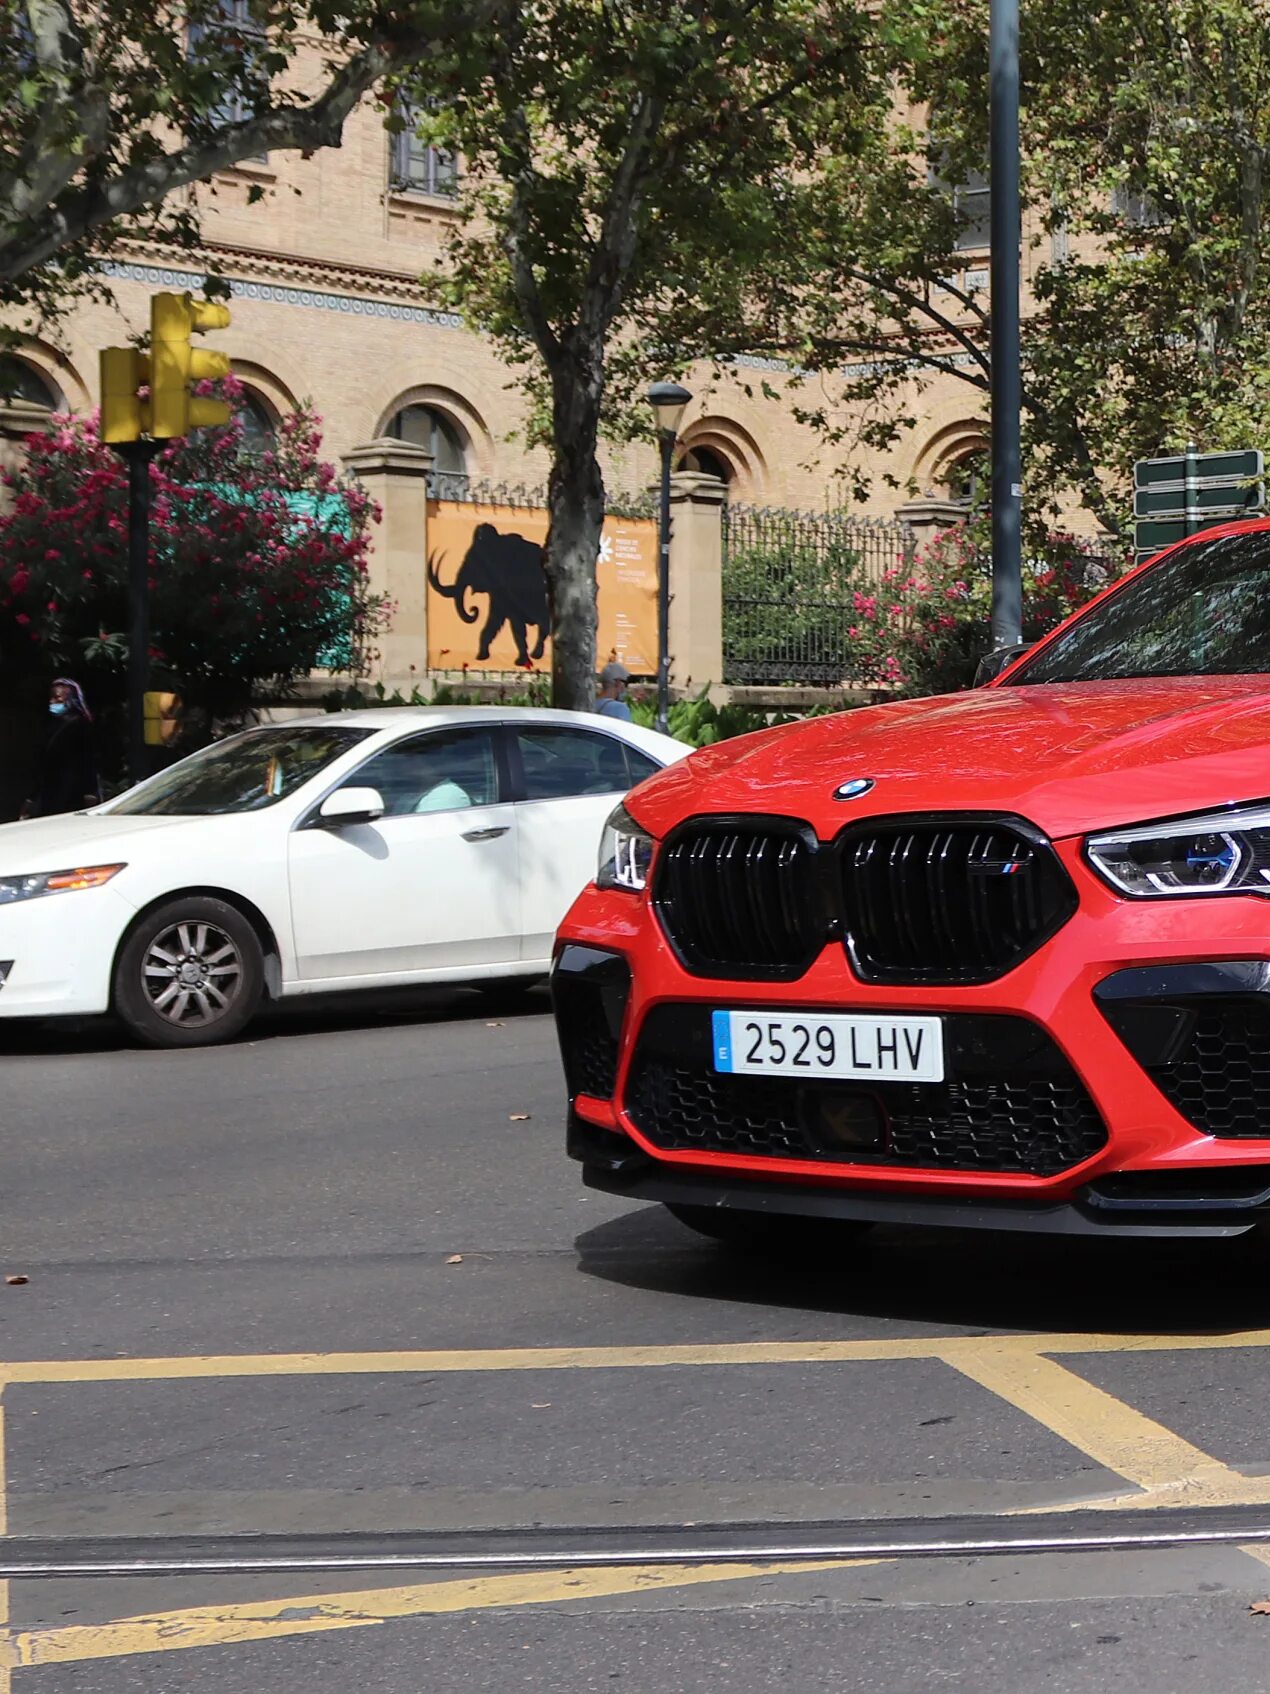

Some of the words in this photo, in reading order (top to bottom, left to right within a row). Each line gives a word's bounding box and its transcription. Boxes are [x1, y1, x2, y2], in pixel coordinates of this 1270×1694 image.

[719, 1047, 728, 1060] E
[745, 1022, 836, 1067] 2529
[850, 1026, 924, 1070] LHV
